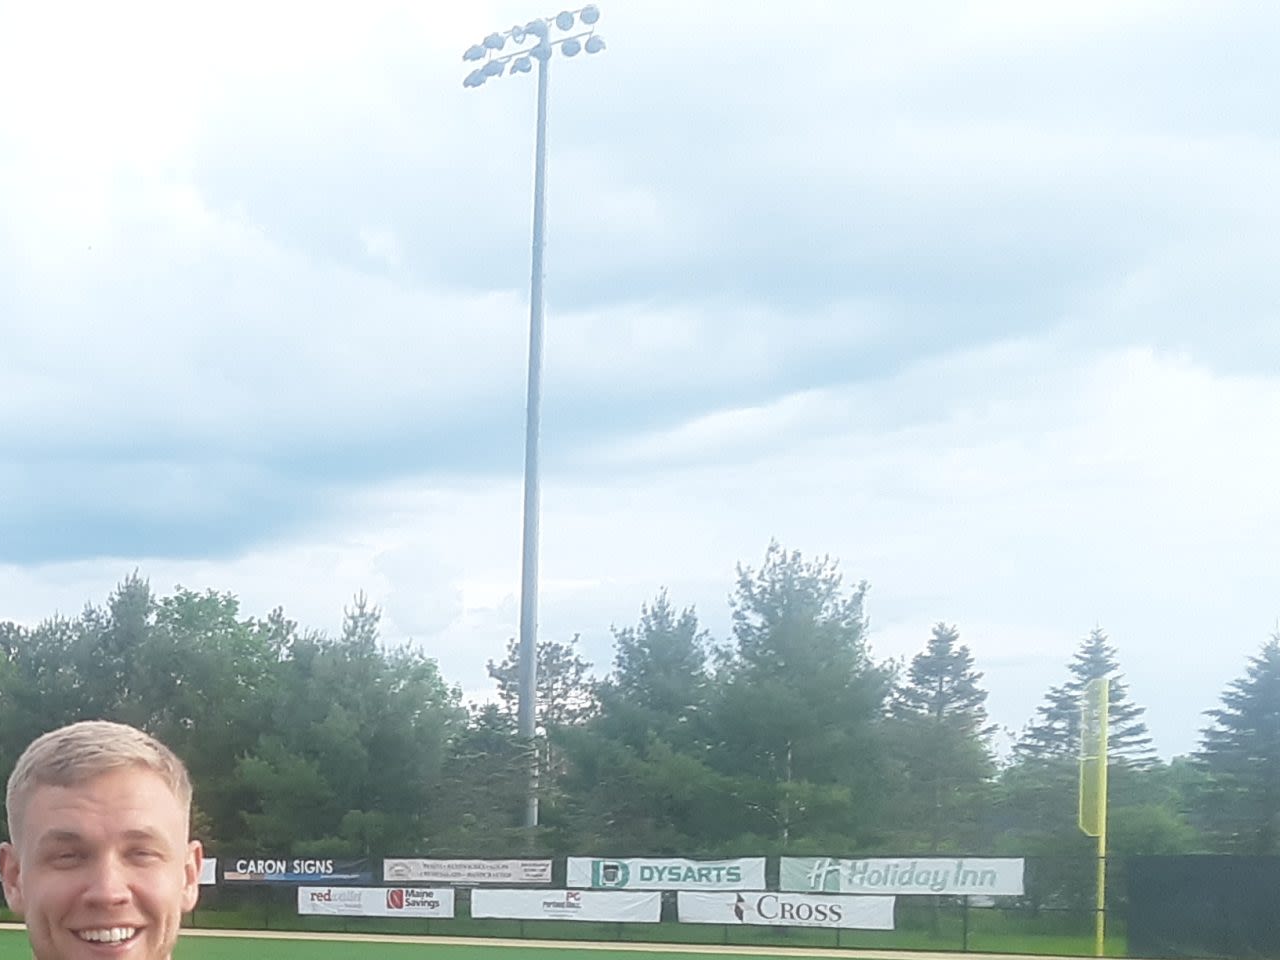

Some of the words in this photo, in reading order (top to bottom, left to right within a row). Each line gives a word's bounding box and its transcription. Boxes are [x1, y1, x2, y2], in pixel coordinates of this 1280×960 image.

[236, 859, 286, 874] CARON
[293, 860, 333, 874] SIGNS
[640, 865, 741, 883] DYSARTS
[848, 860, 951, 891] Holiday
[953, 861, 998, 887] Inn
[405, 889, 433, 898] Maine
[405, 898, 439, 909] Savings
[757, 895, 842, 922] CROSS
